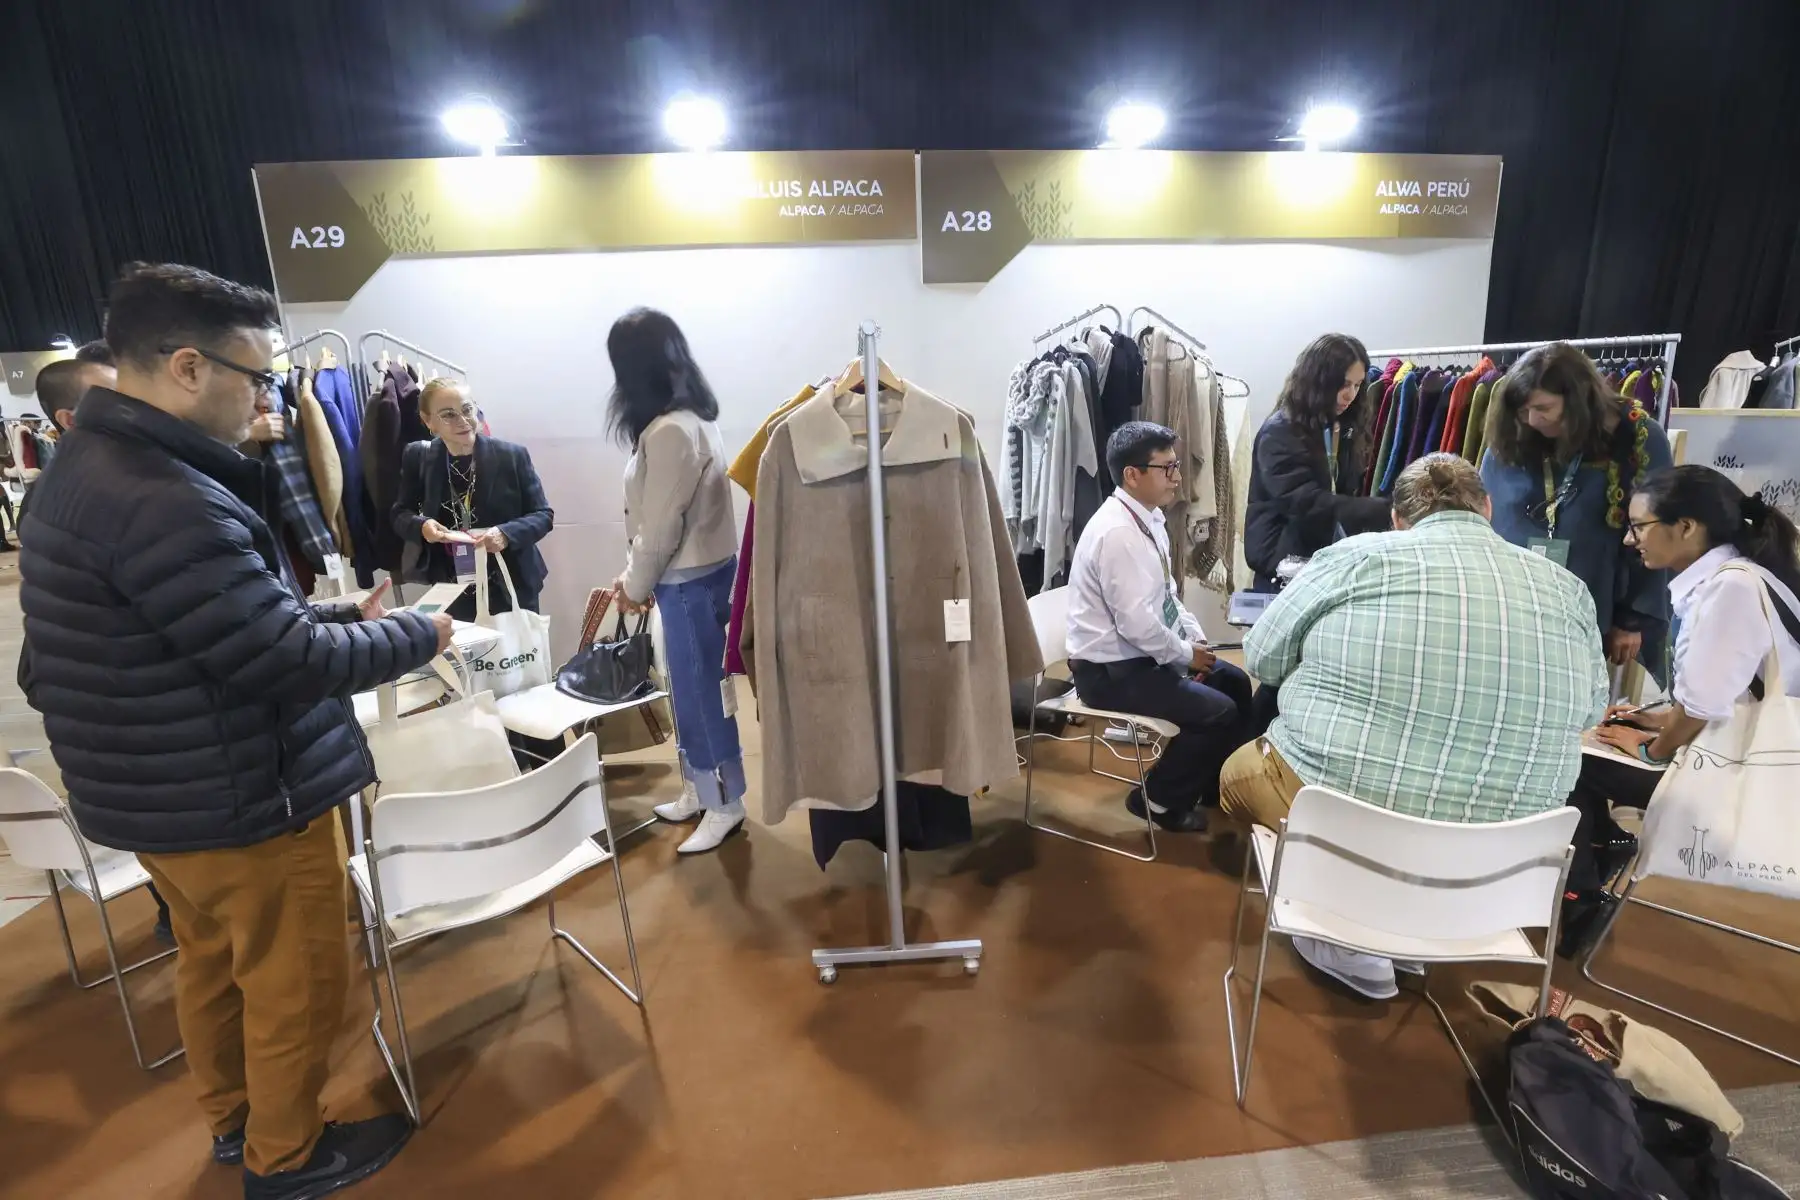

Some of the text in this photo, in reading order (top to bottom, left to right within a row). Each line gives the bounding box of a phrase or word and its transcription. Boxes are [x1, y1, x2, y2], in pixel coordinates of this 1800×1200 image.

[808, 179, 883, 197] ALPACA
[1375, 177, 1470, 198] ALWA PERÚ
[779, 204, 826, 217] ALPACA
[838, 203, 884, 216] ALPACA
[1379, 203, 1420, 214] ALPACA
[1429, 204, 1468, 215] ALPACA
[941, 210, 992, 232] A28
[290, 225, 345, 249] A29
[12, 370, 24, 379] A7
[474, 659, 494, 672] Be
[499, 653, 535, 670] Green
[1724, 860, 1797, 875] ALPACA
